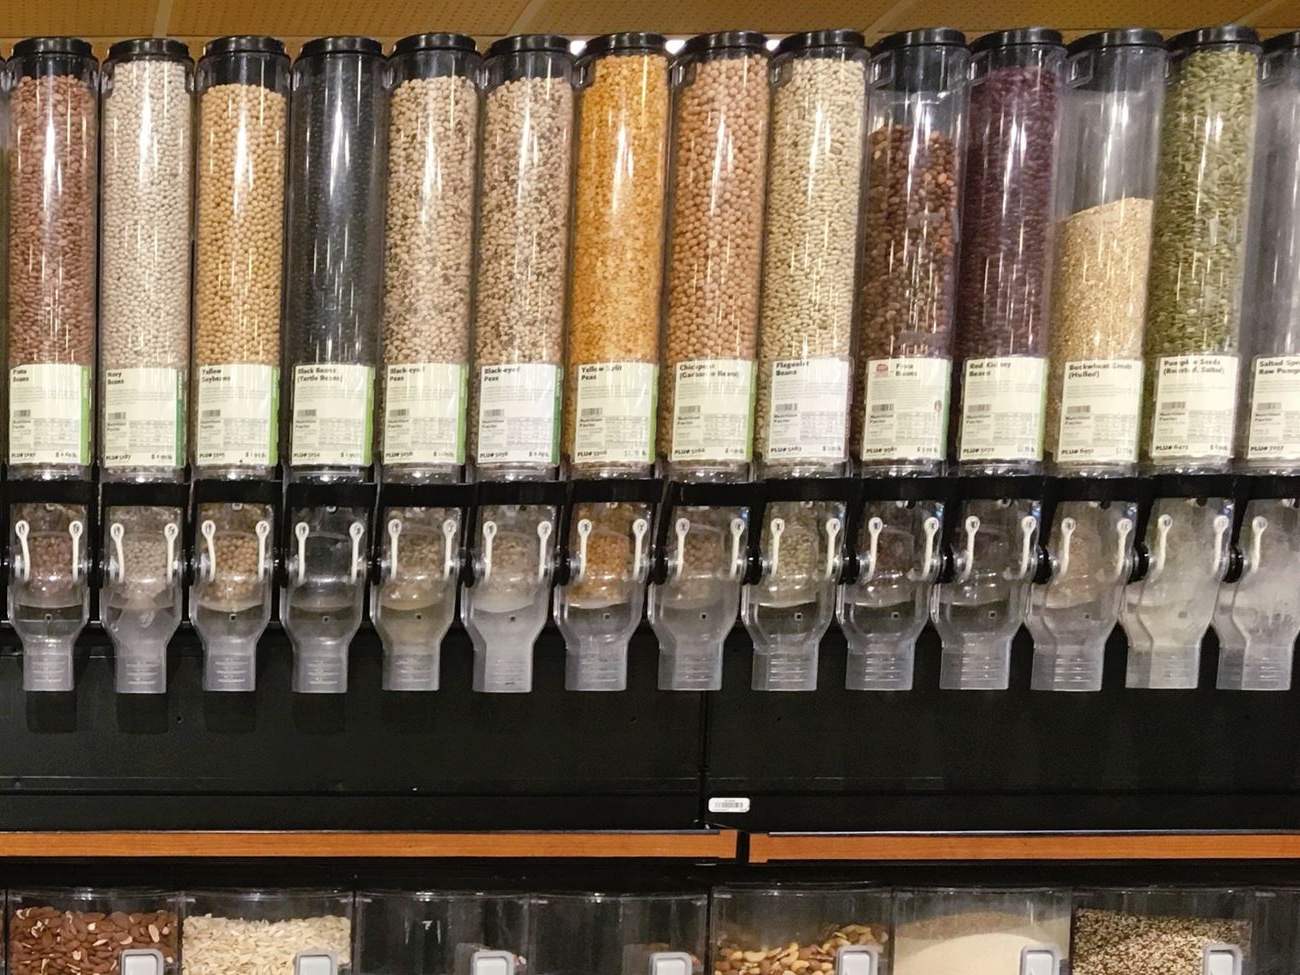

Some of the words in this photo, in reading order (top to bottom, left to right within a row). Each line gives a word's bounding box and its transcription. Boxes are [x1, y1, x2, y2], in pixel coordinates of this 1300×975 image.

[986, 361, 1011, 370] Kidey
[1069, 363, 1110, 371] Buckwheat
[1164, 358, 1197, 368] Pumpkn
[1259, 359, 1284, 368] Salted
[107, 371, 122, 379] Navy
[581, 373, 597, 381] Peas
[1068, 370, 1100, 380] (Hulled)
